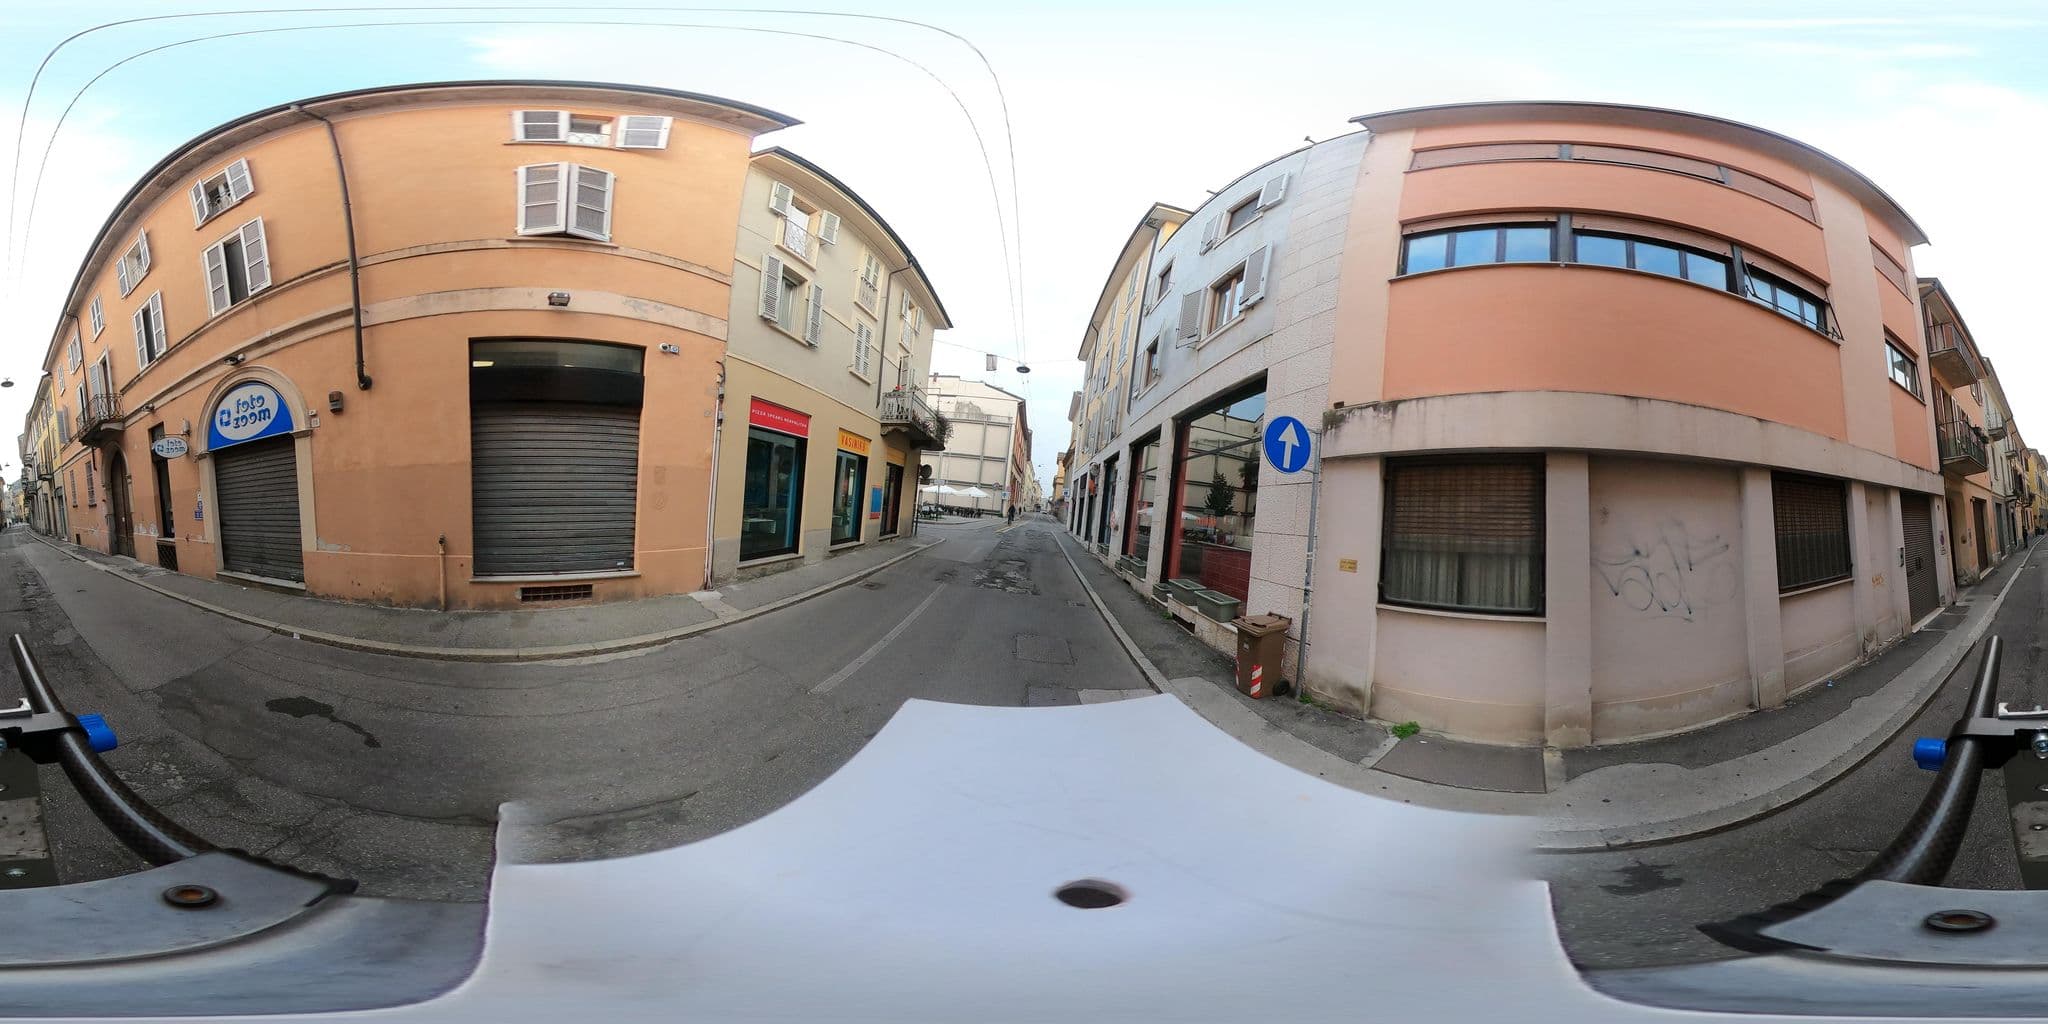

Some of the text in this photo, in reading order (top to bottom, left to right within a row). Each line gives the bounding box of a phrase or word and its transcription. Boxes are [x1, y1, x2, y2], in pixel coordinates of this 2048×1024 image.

[236, 395, 265, 414] foto
[232, 407, 271, 429] zoom
[165, 446, 186, 454] zoom
